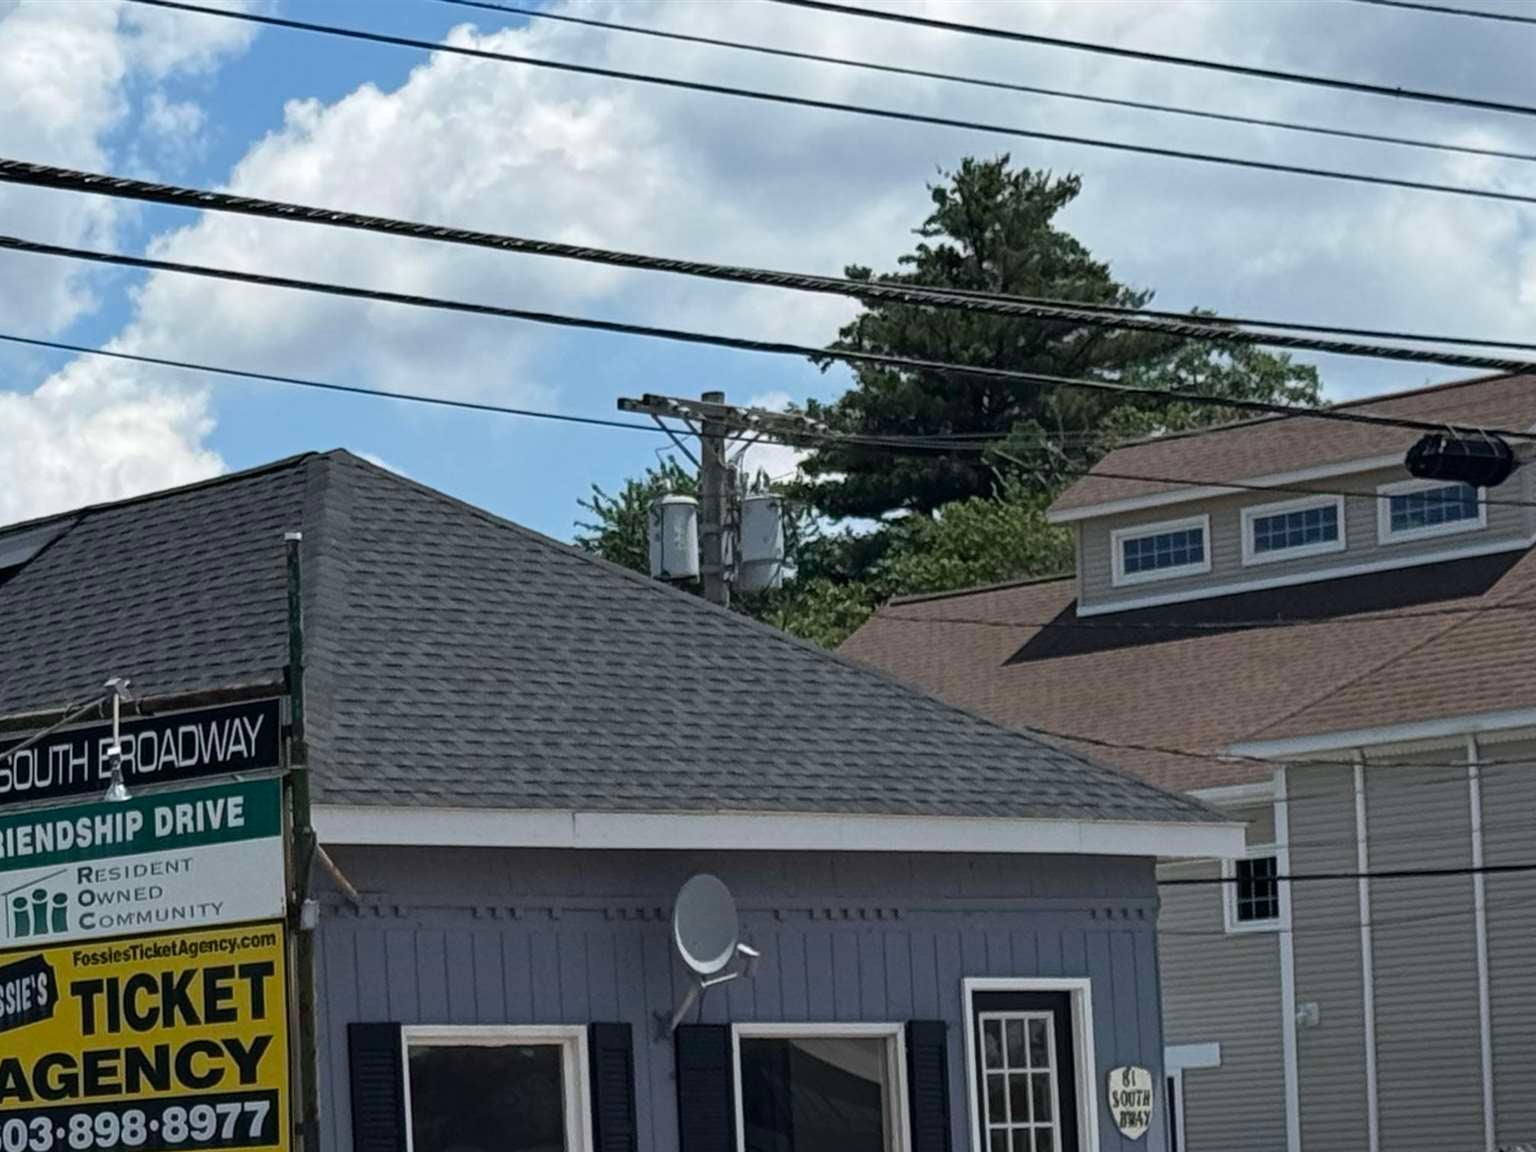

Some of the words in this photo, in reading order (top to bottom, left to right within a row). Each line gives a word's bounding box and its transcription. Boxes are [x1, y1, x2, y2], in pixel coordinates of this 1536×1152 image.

[155, 796, 245, 838] DRIVE
[77, 858, 193, 884] RESIDENT
[78, 886, 163, 907] OWNED
[79, 902, 224, 930] COMMUNITY
[73, 933, 276, 967] FossiesTicketAgency.com
[70, 961, 275, 1036] TICKET
[1122, 1068, 1136, 1088] 81
[1112, 1089, 1151, 1108] SOUTH
